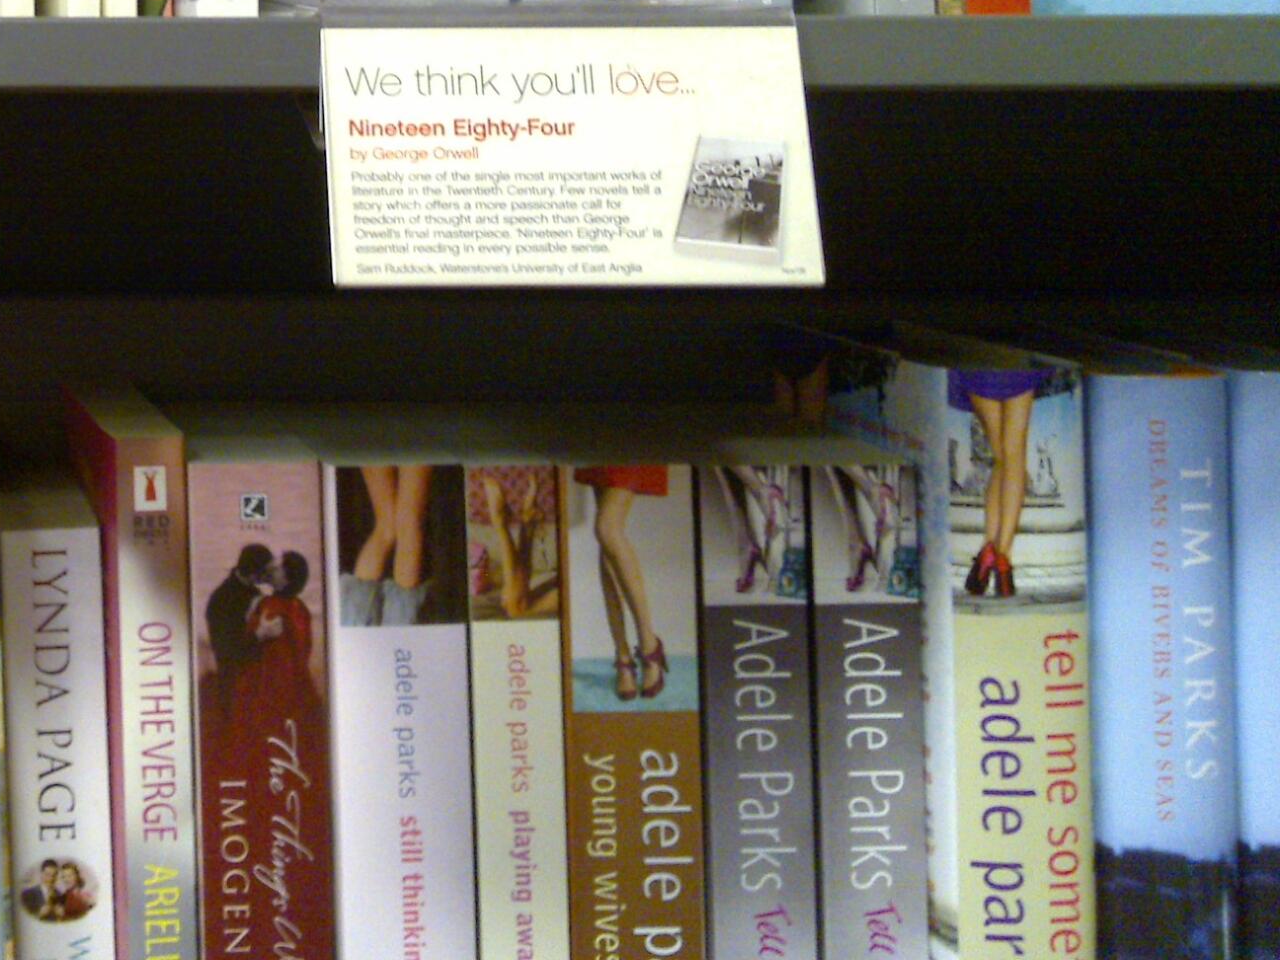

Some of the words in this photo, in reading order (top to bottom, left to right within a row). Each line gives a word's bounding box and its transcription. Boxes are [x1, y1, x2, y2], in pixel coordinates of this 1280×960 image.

[344, 66, 403, 96] We
[414, 64, 500, 96] think
[511, 64, 596, 103] you'll
[348, 119, 446, 137] Nineteen
[453, 118, 576, 141] Eighty-Four
[349, 147, 368, 163] by
[372, 147, 429, 162] George
[433, 147, 480, 160] Orwell
[351, 170, 404, 183] Probably
[475, 170, 510, 183] single
[515, 170, 545, 181] most
[548, 170, 606, 183] important
[610, 170, 647, 181] works
[386, 200, 421, 210] which
[511, 200, 577, 212] passionate
[589, 185, 628, 195] novels
[354, 214, 405, 224] freedom
[425, 214, 471, 226] thought
[503, 214, 549, 226] speech
[552, 214, 580, 224] than
[583, 214, 630, 226] George
[1148, 418, 1168, 534] DREAMS
[1181, 458, 1212, 569] TIM
[1151, 541, 1168, 573] OF
[31, 549, 72, 709] LYNDA
[138, 622, 172, 667] ON
[1152, 586, 1174, 679] RIVERS
[139, 676, 175, 735] THE
[394, 647, 420, 716] adele
[507, 643, 532, 712] adele
[732, 619, 795, 752] Adele
[843, 618, 904, 751] Adele
[1044, 628, 1086, 709] tell
[1182, 605, 1218, 782] PARKS
[507, 719, 531, 793] parks
[979, 677, 1037, 835] adele
[1154, 690, 1175, 749] AND
[36, 727, 77, 842] PAGE
[140, 740, 177, 842] VERGE
[393, 725, 421, 799] parks
[1046, 731, 1080, 806] me
[1158, 757, 1176, 824] SEAS
[399, 815, 424, 864] still
[583, 753, 616, 857] young
[639, 749, 694, 902] adele
[737, 771, 797, 892] Parks
[847, 769, 908, 891] Parks
[219, 778, 252, 956] IMOGEN
[510, 810, 538, 903] playing
[754, 904, 793, 956] Tell
[864, 901, 903, 955] Tell
